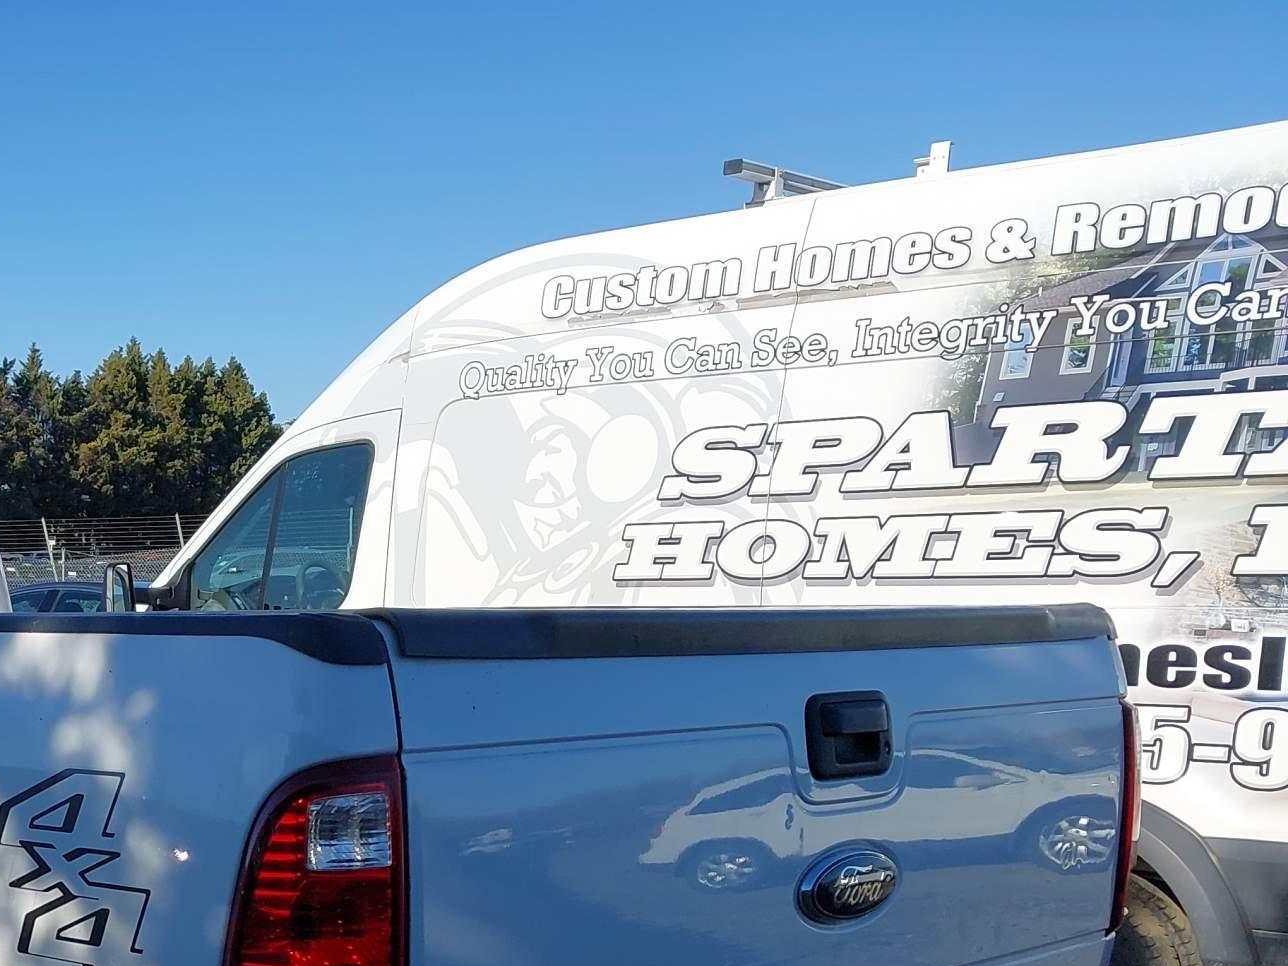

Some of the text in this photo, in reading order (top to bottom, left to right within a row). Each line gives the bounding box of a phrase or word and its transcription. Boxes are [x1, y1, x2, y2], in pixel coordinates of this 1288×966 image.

[541, 257, 743, 319] Custom
[754, 225, 972, 293] Homes
[985, 217, 1037, 265] &
[459, 353, 578, 400] Quality
[586, 346, 655, 383] You
[665, 337, 743, 375] Can
[750, 328, 839, 368] See,
[851, 304, 1057, 362] Integrity
[1069, 294, 1169, 338] You
[612, 506, 1202, 590] HOMES,
[833, 865, 895, 905] Ford
